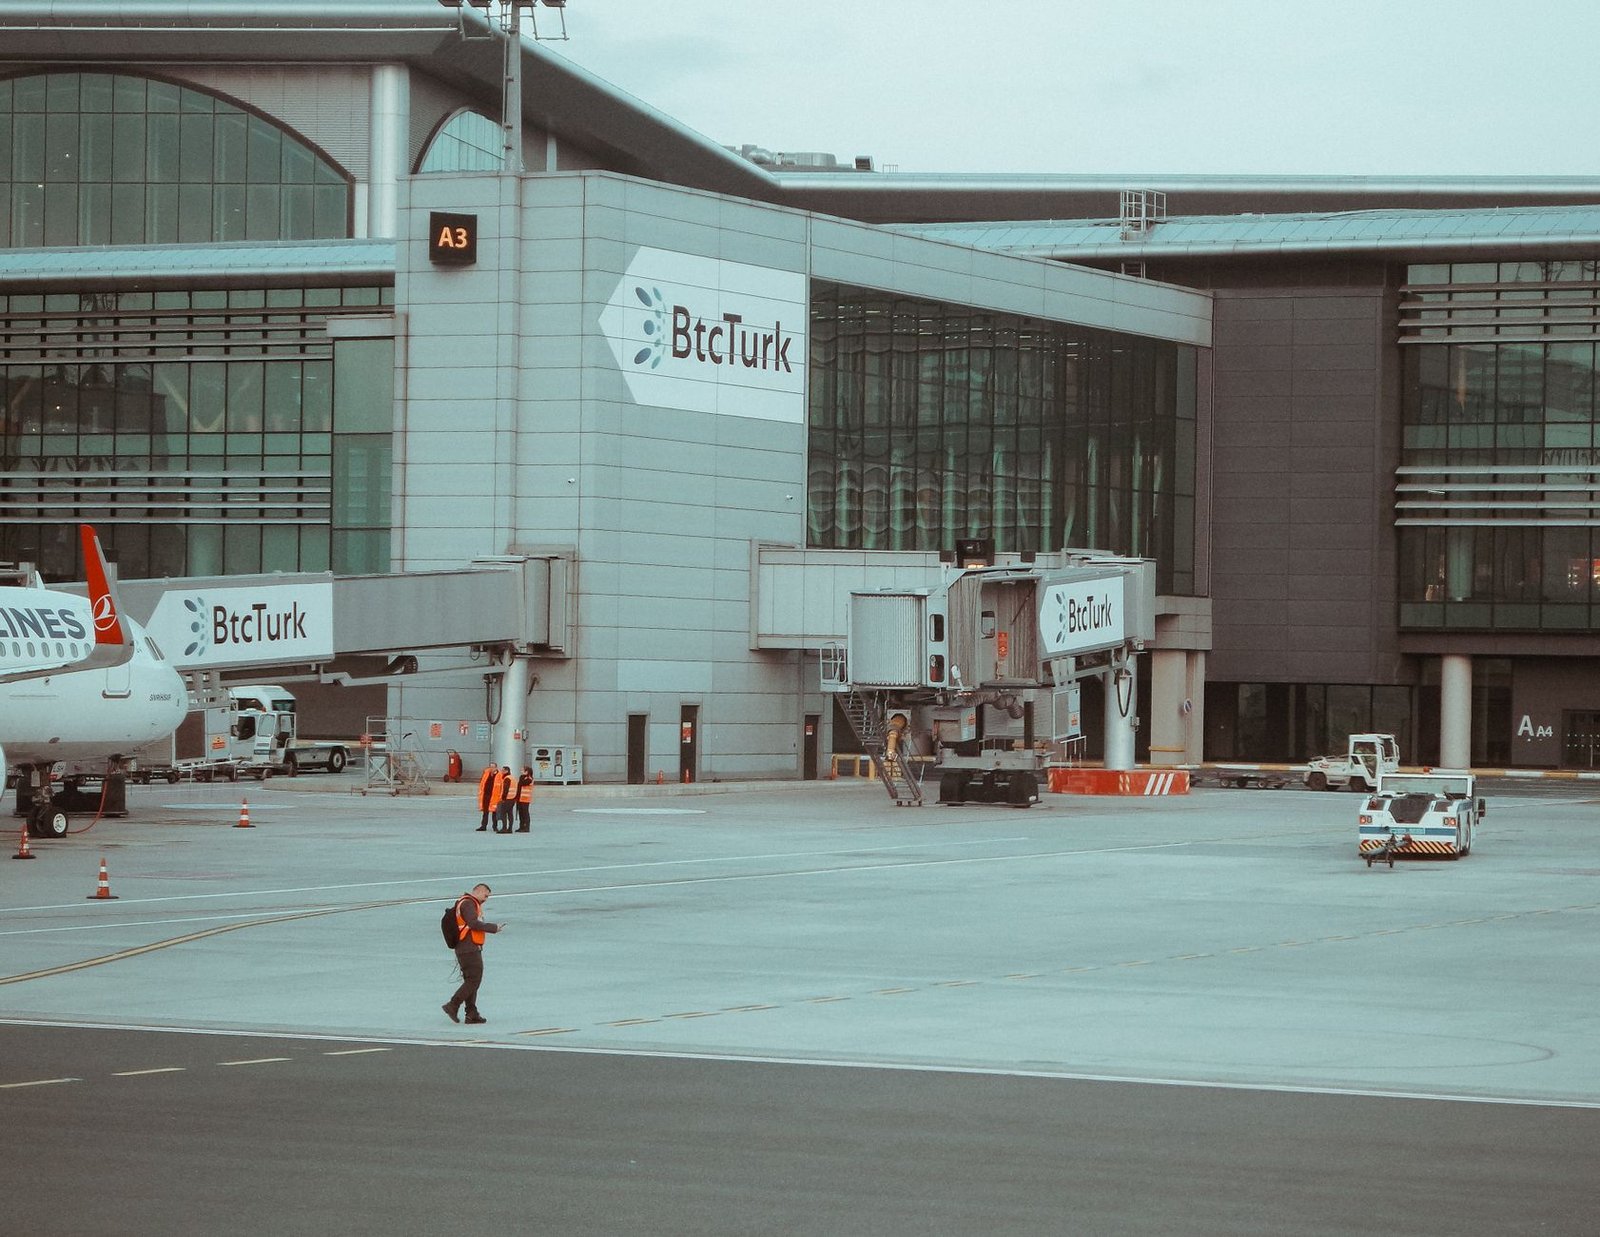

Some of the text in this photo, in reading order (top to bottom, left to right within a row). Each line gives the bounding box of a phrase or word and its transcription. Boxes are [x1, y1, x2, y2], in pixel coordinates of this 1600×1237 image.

[438, 226, 467, 248] A3
[672, 305, 792, 373] BtcTurk
[213, 601, 307, 645] BtcTurk
[1069, 593, 1112, 633] BtcTurk
[1517, 714, 1553, 737] A A4
